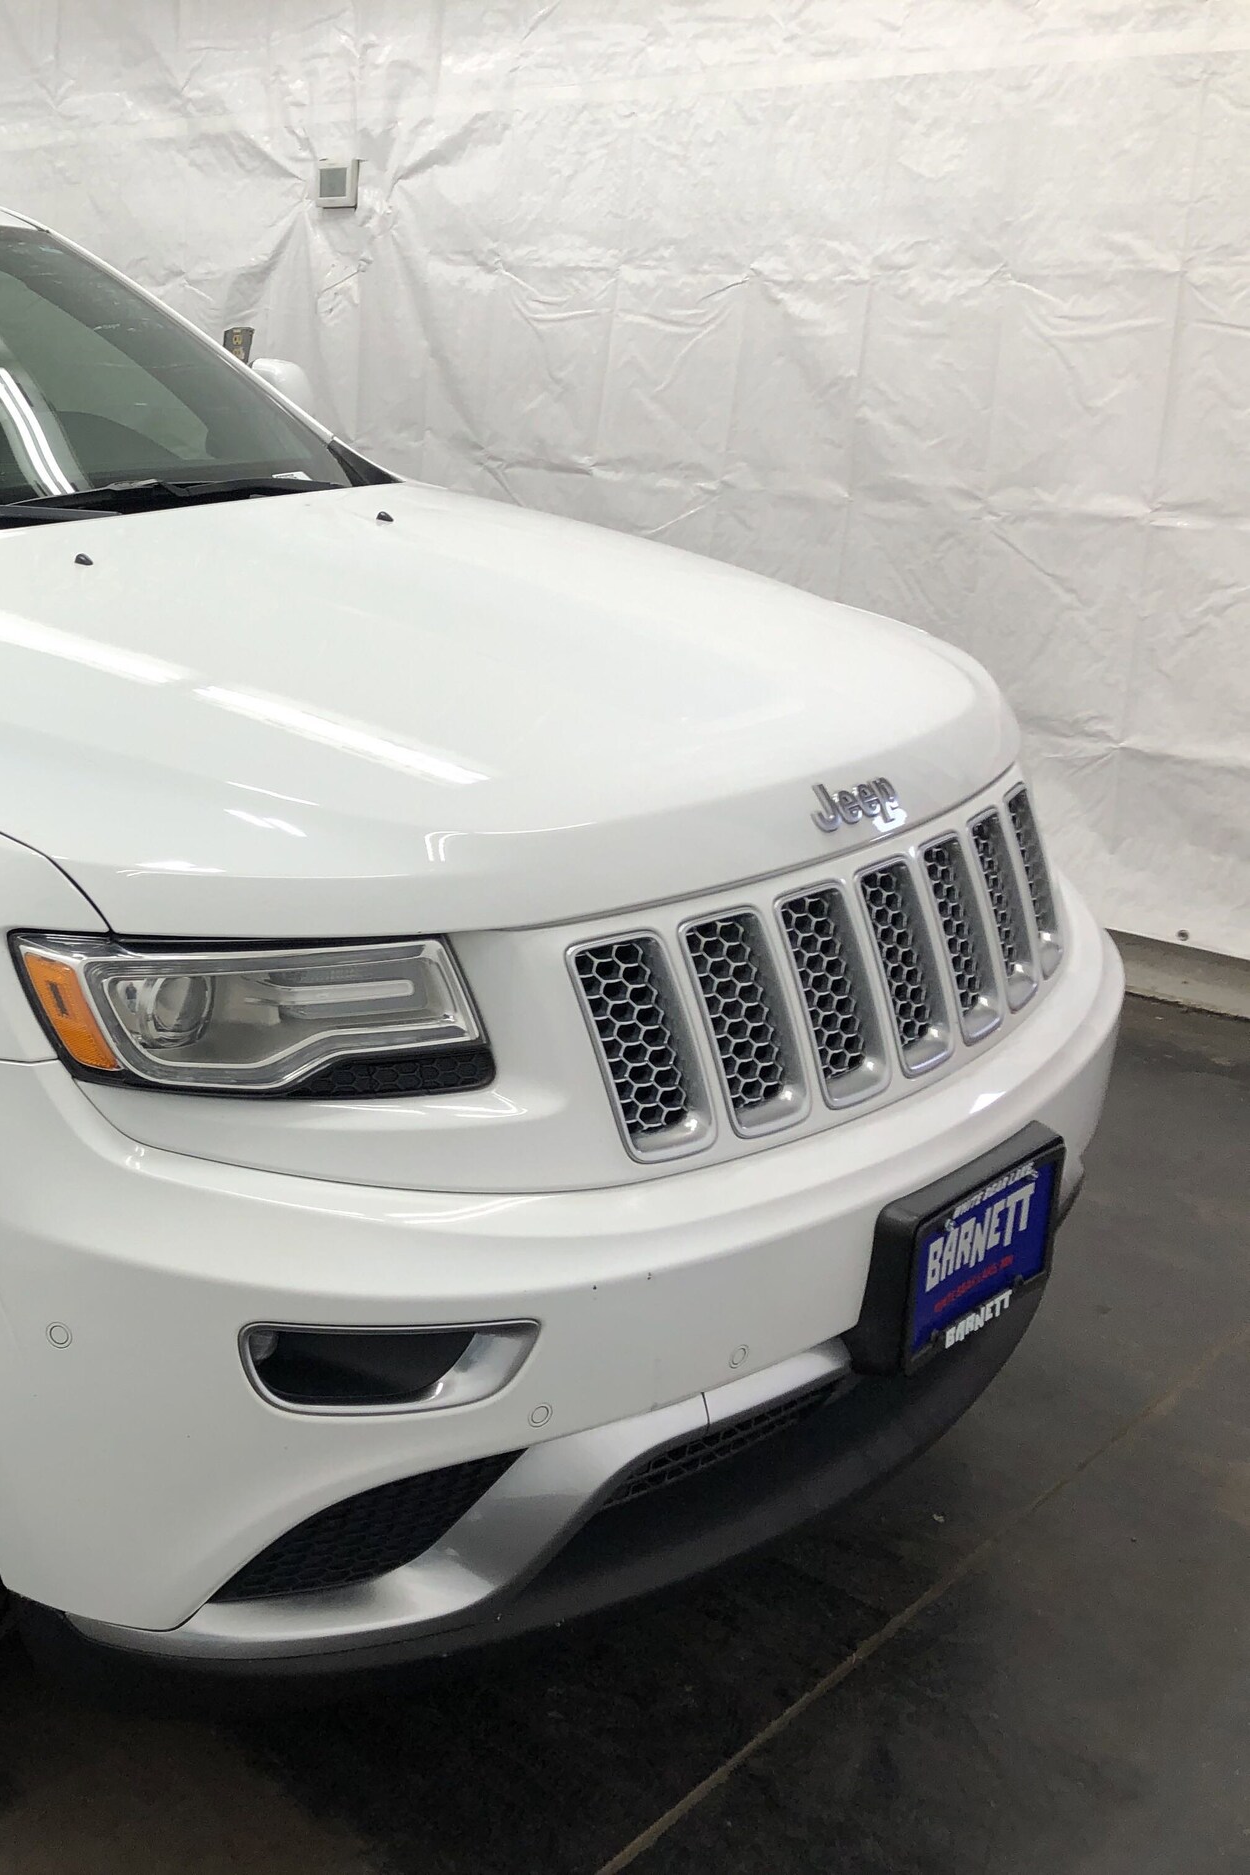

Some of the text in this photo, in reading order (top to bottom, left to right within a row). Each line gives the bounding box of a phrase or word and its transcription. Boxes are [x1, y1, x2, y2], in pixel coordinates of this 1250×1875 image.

[810, 777, 898, 833] Jeep
[925, 1182, 1036, 1292] BARNETT
[945, 1290, 1012, 1349] BARNETT
